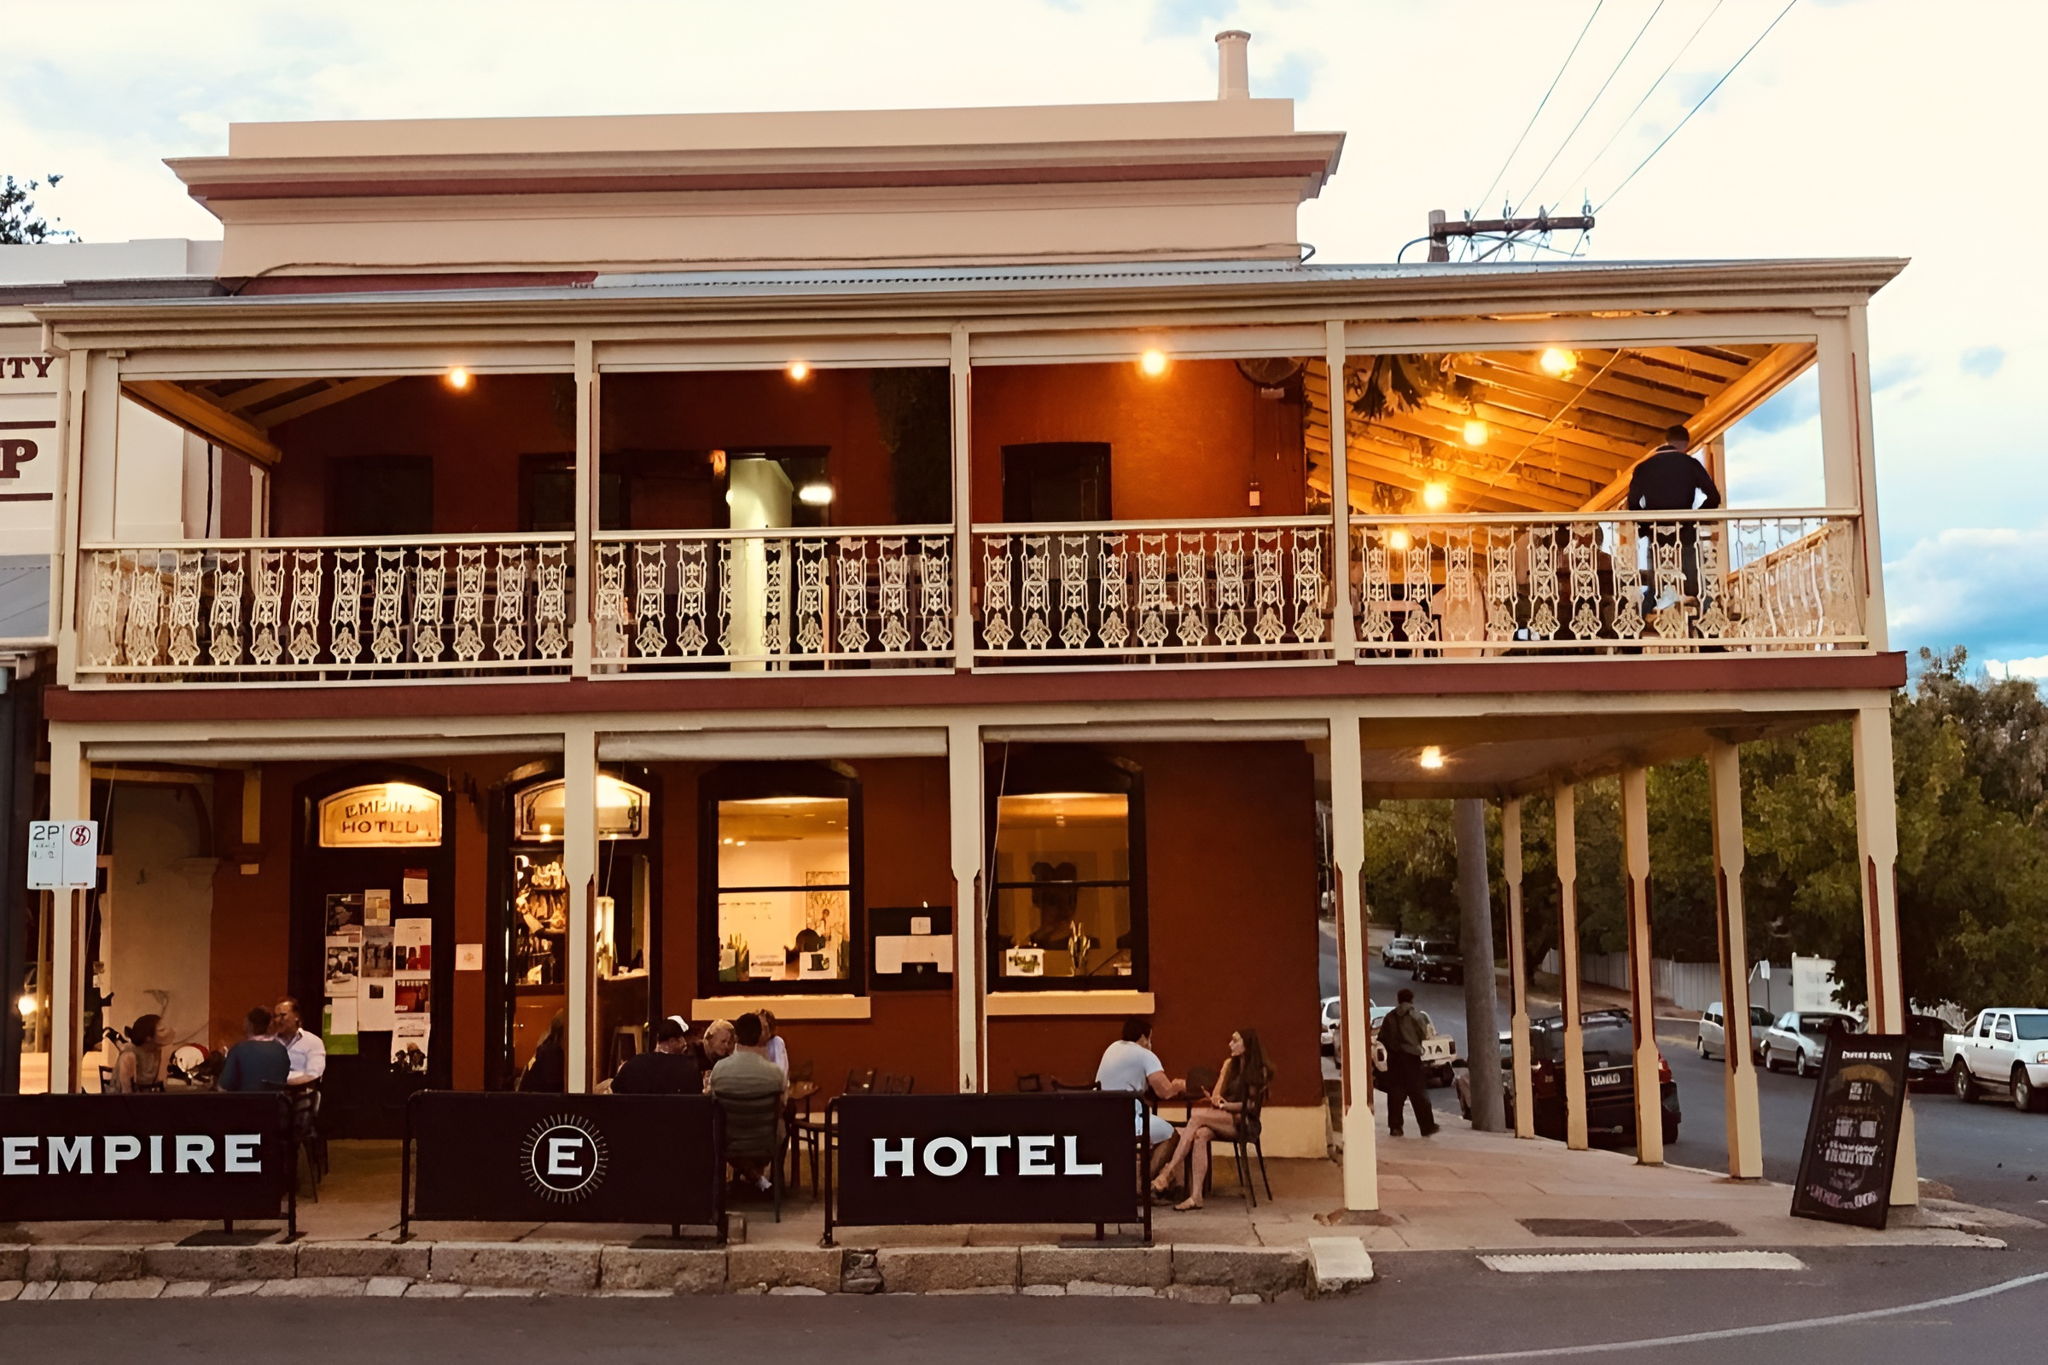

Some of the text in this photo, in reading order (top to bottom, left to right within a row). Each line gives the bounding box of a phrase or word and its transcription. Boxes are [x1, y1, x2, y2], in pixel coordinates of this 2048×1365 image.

[33, 825, 60, 840] 2P
[2, 1134, 261, 1175] EMPIRE
[547, 1138, 583, 1176] E
[872, 1134, 1103, 1177] HOTEL
